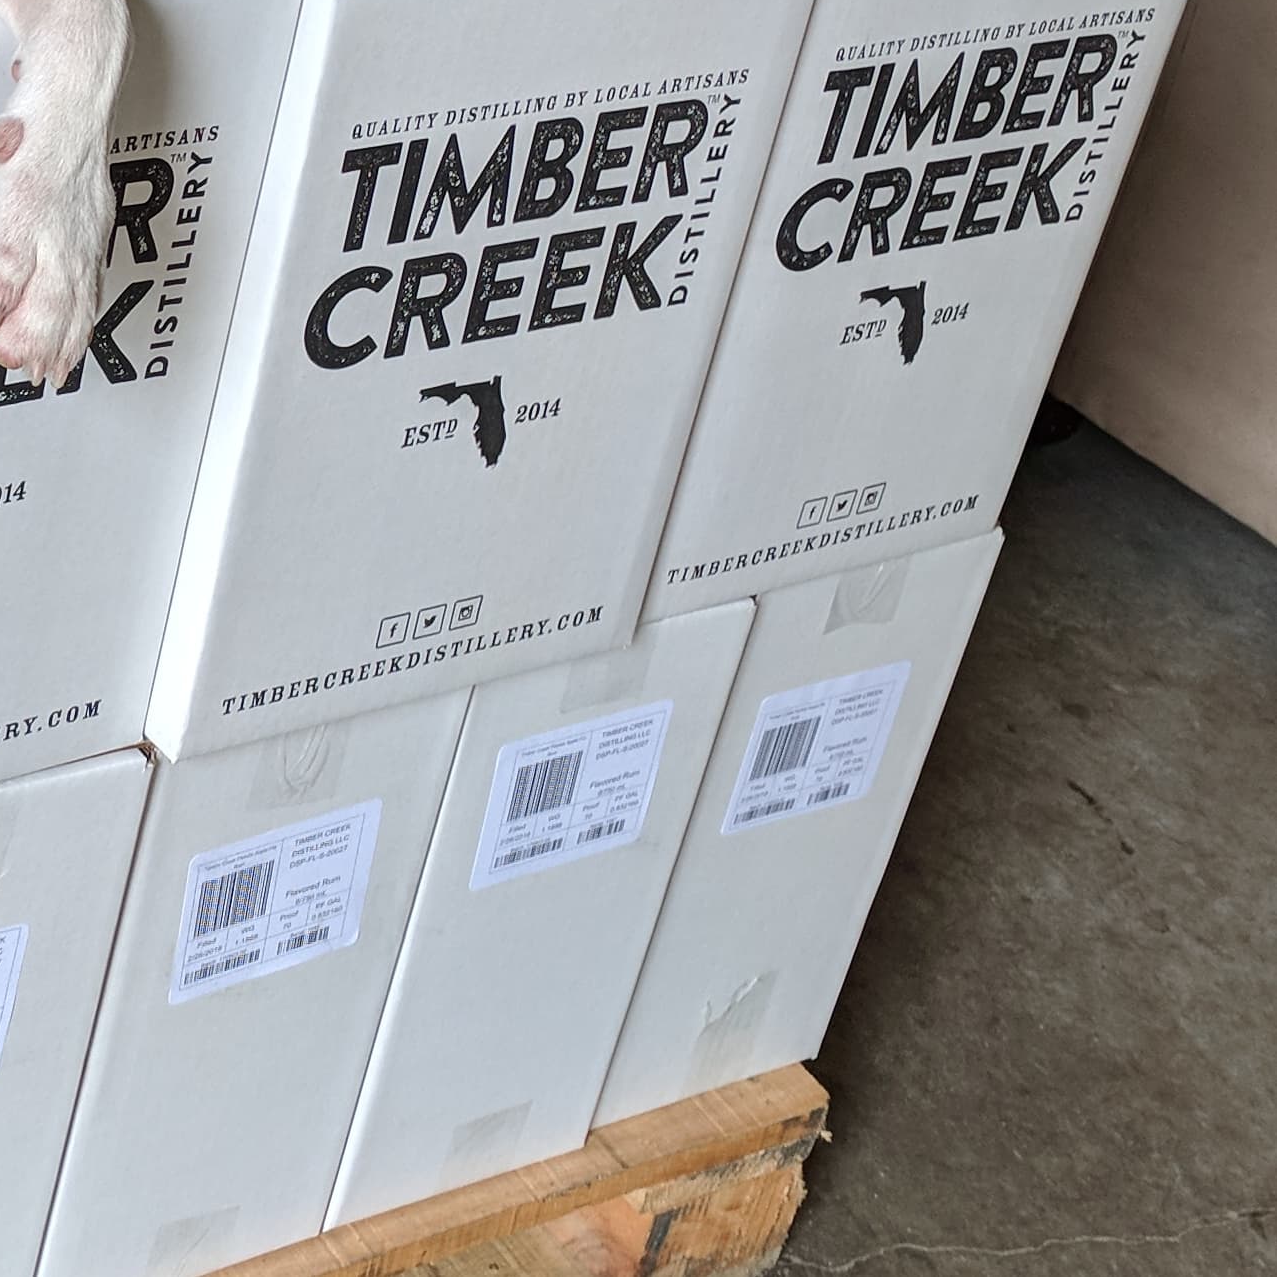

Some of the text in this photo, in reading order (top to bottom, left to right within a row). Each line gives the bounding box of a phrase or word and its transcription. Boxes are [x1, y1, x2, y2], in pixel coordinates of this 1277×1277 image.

[835, 7, 1156, 63] QUALITY DISTILLING BY LOCAL ARTISANS
[109, 125, 220, 155] ARTISANS
[351, 69, 749, 139] QUALITY DISTILLING BY LOCAL ARTISANS
[817, 33, 1118, 165] TIMBER
[1065, 29, 1147, 223] DISTILLERY
[341, 98, 709, 253] TIMBER
[667, 93, 741, 306] DISTILLERY
[776, 137, 1087, 272] CREEK
[145, 151, 213, 379] DISTILLERY
[304, 213, 684, 370] CREEK
[931, 302, 971, 325] 2014
[515, 398, 561, 424] 2014
[667, 494, 980, 585] TIMBERCREEKDISTILLERY.COM
[222, 605, 604, 716] TIMBERCREEKDISTILLERY.COM
